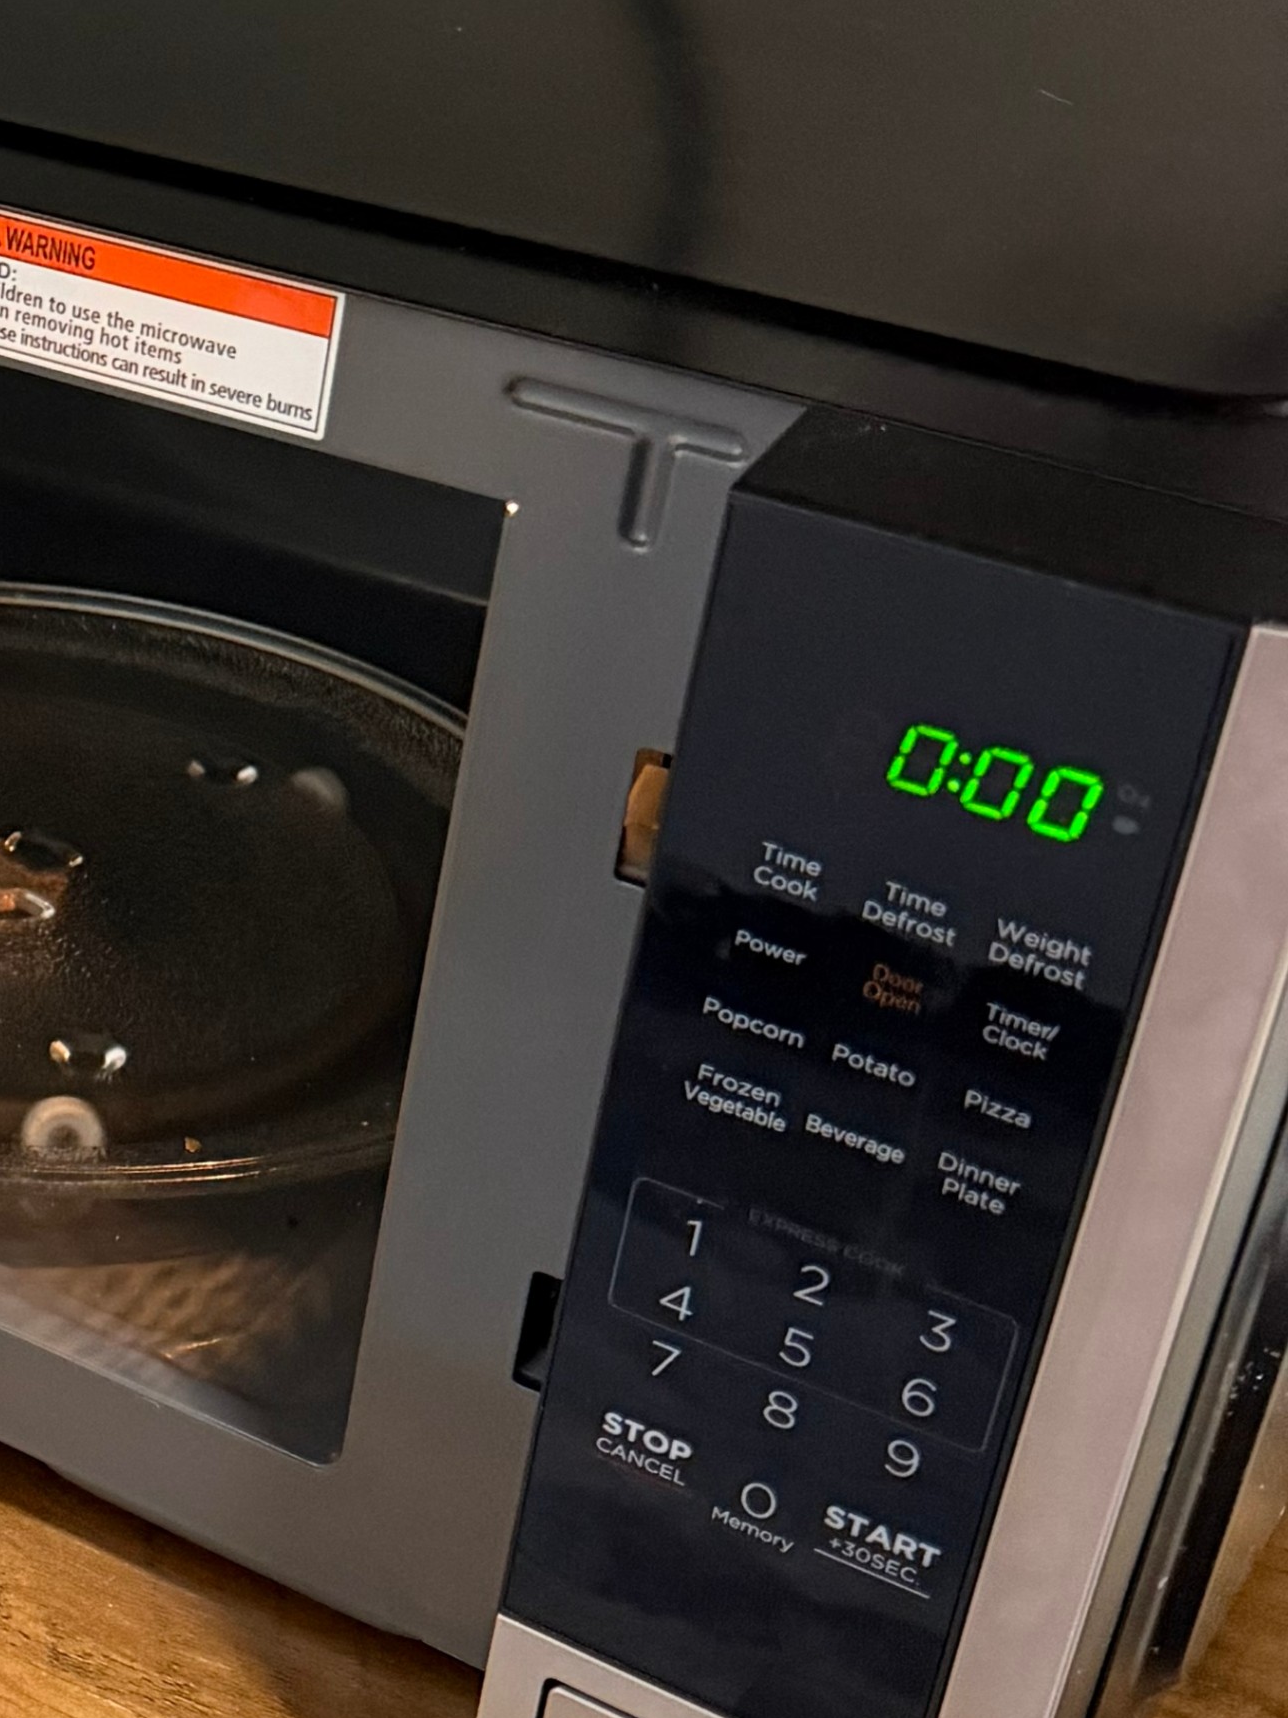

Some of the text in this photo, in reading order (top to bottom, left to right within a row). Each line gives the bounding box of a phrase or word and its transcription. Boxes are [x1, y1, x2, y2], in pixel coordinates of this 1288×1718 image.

[6, 226, 95, 270] WARNING
[14, 309, 94, 345] removing
[99, 327, 128, 350] hot
[134, 335, 181, 364] items
[49, 296, 66, 314] to
[71, 305, 100, 323] use
[106, 311, 134, 332] the
[139, 322, 236, 359] microwave
[20, 328, 107, 366] instructions
[111, 357, 138, 374] can
[142, 365, 187, 388] result
[190, 373, 205, 392] in
[208, 382, 262, 408] severe
[266, 392, 312, 421] burns
[886, 723, 1104, 843] 0:00
[762, 841, 821, 876] Time
[753, 865, 817, 900] Cook
[886, 880, 946, 916] Time
[862, 900, 955, 946] Defrost
[997, 918, 1091, 965] Weight
[734, 929, 805, 964] Power
[988, 941, 1084, 989] Defrost
[862, 980, 920, 1013] Open
[871, 963, 923, 993] Door
[702, 996, 803, 1048] Popcorn
[986, 1002, 1059, 1040] Timer/
[982, 1025, 1046, 1059] Clock
[697, 1063, 780, 1106] Frozen
[832, 1043, 915, 1086] Potato
[684, 1080, 785, 1131] Vegetable
[964, 1089, 1030, 1128] Pizza
[805, 1113, 904, 1163] Beverage
[938, 1151, 1020, 1194] Dinner
[941, 1177, 1004, 1214] Plate
[687, 1220, 702, 1256] 1
[659, 1286, 692, 1320] 4
[793, 1265, 828, 1305] 2
[779, 1327, 813, 1366] 5
[919, 1310, 955, 1351] 3
[651, 1340, 680, 1375] 7
[763, 1390, 797, 1428] 8
[901, 1378, 936, 1416] 6
[602, 1412, 691, 1459] STOP
[596, 1437, 684, 1486] CANCEL
[884, 1439, 919, 1477] 9
[711, 1506, 793, 1552] Memory
[824, 1505, 940, 1566] START
